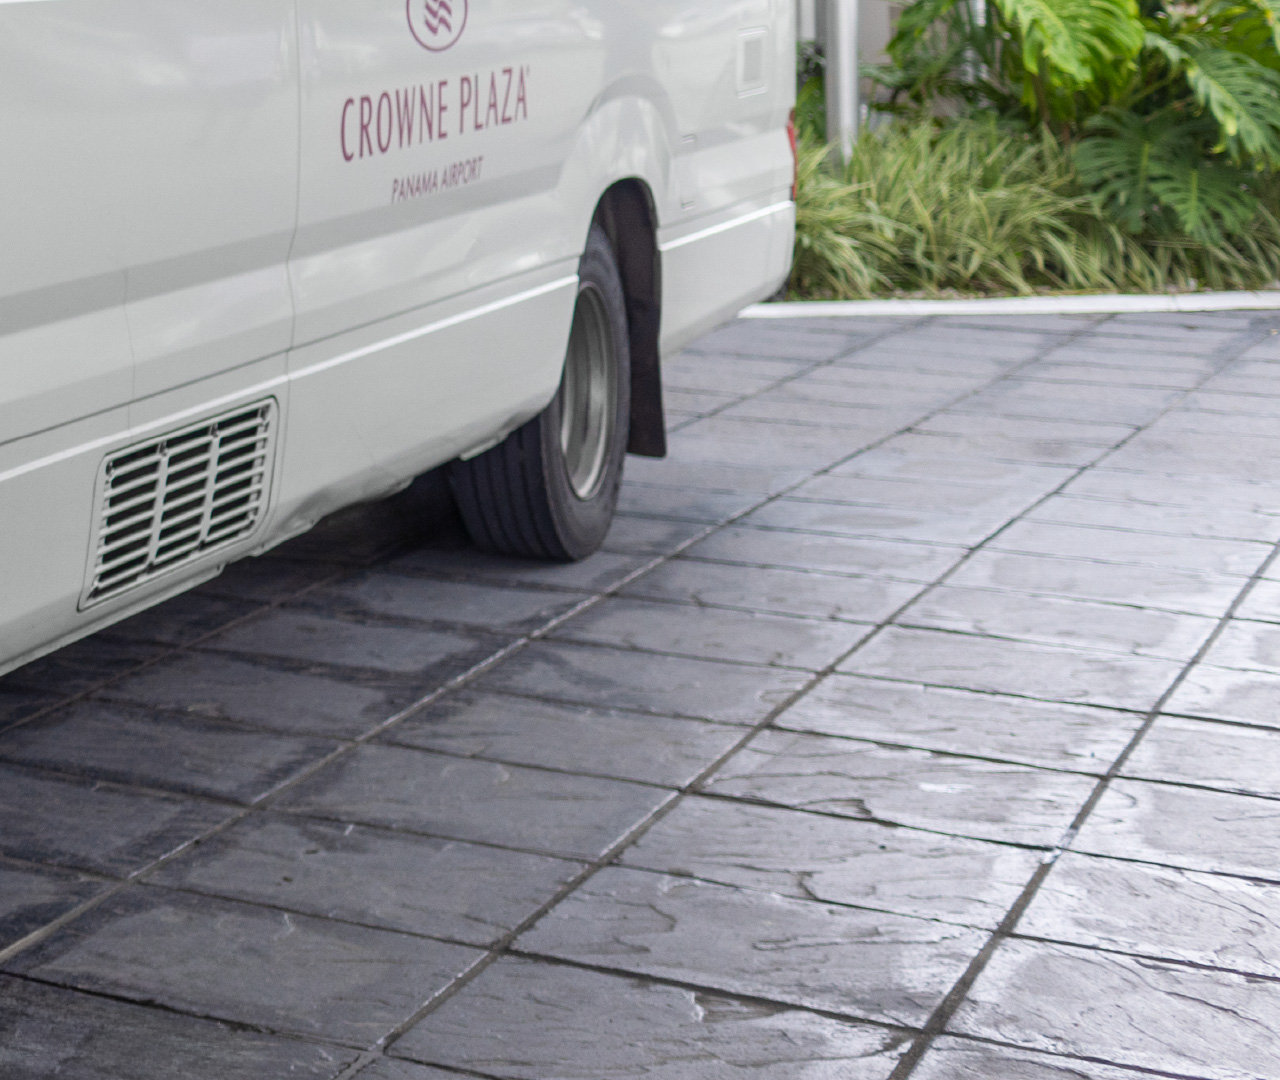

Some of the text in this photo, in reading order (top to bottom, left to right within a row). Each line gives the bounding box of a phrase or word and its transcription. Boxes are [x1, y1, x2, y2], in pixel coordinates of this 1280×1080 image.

[340, 79, 448, 163] CROWNE
[391, 155, 484, 204] PANAMA AIRPORT
